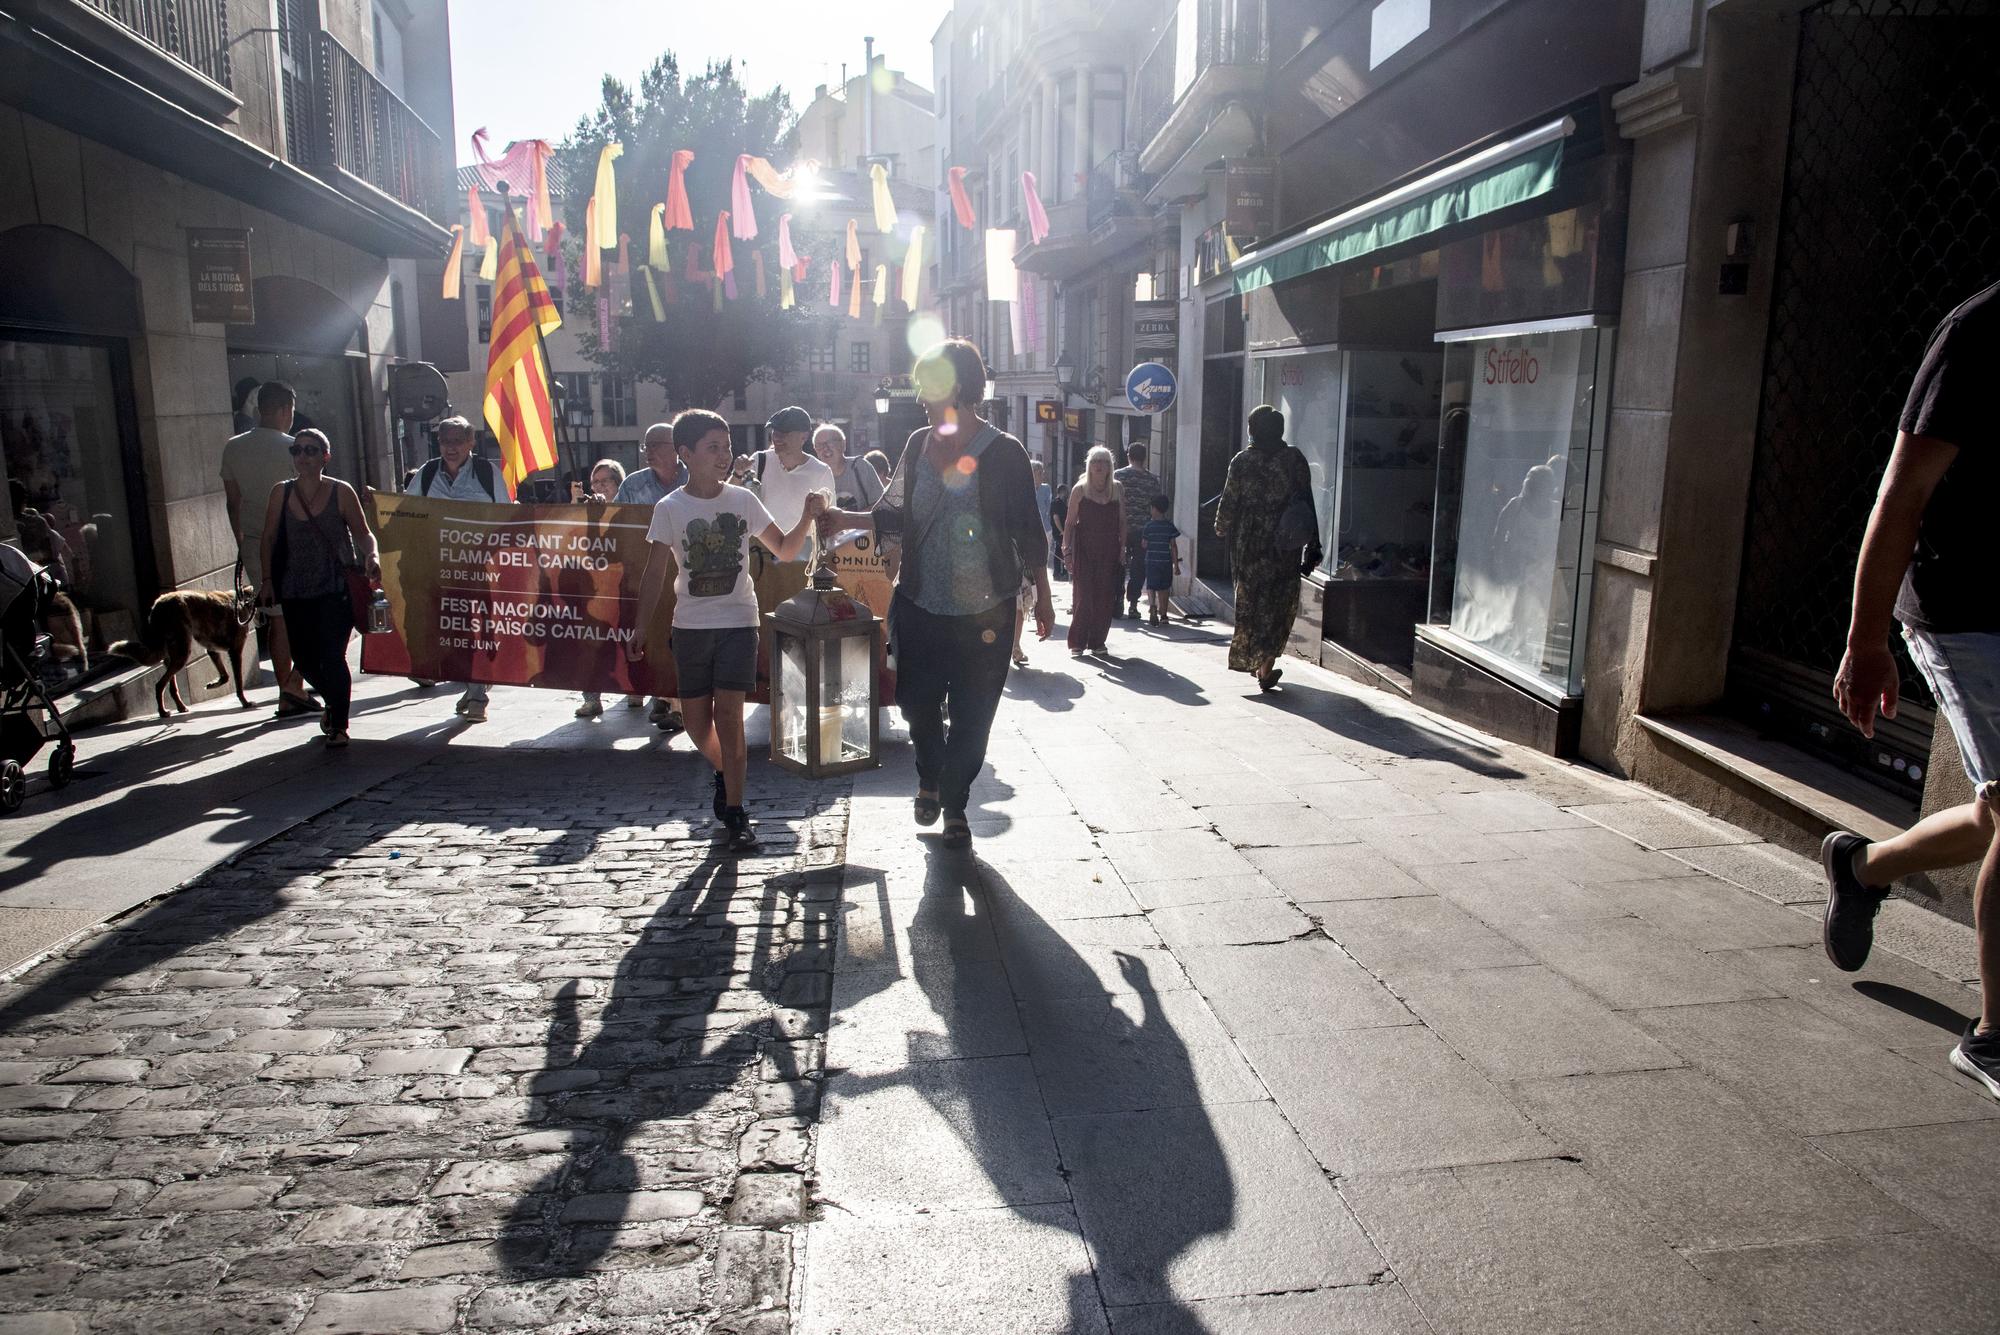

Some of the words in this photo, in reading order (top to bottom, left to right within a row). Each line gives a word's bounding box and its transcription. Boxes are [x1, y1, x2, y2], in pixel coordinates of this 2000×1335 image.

[200, 272, 210, 281] LA
[212, 272, 240, 282] BOTIGA
[198, 283, 217, 292] DELS
[220, 283, 244, 293] TURCS
[1140, 323, 1170, 332] ZEBRA
[1486, 347, 1538, 385] Stifelio
[439, 529, 484, 546] FOCS
[487, 533, 511, 547] DE
[515, 533, 563, 550] SANT
[567, 536, 617, 553] JOAN
[439, 548, 495, 566] FLAMA
[499, 551, 533, 568] DEL
[537, 553, 609, 571] CANIGÓ
[832, 552, 891, 567] ÒMNIUM
[440, 569, 451, 580] 23
[454, 570, 468, 581] DE
[470, 571, 500, 583] JUNY
[440, 598, 488, 615] FESTA
[493, 602, 583, 621] NACIONAL
[440, 615, 481, 632] DELS
[485, 617, 546, 637] PAÏSOS
[551, 624, 632, 642] CATALAN
[439, 637, 451, 648] 24
[454, 638, 468, 649] DE
[471, 639, 501, 651] JUNY
